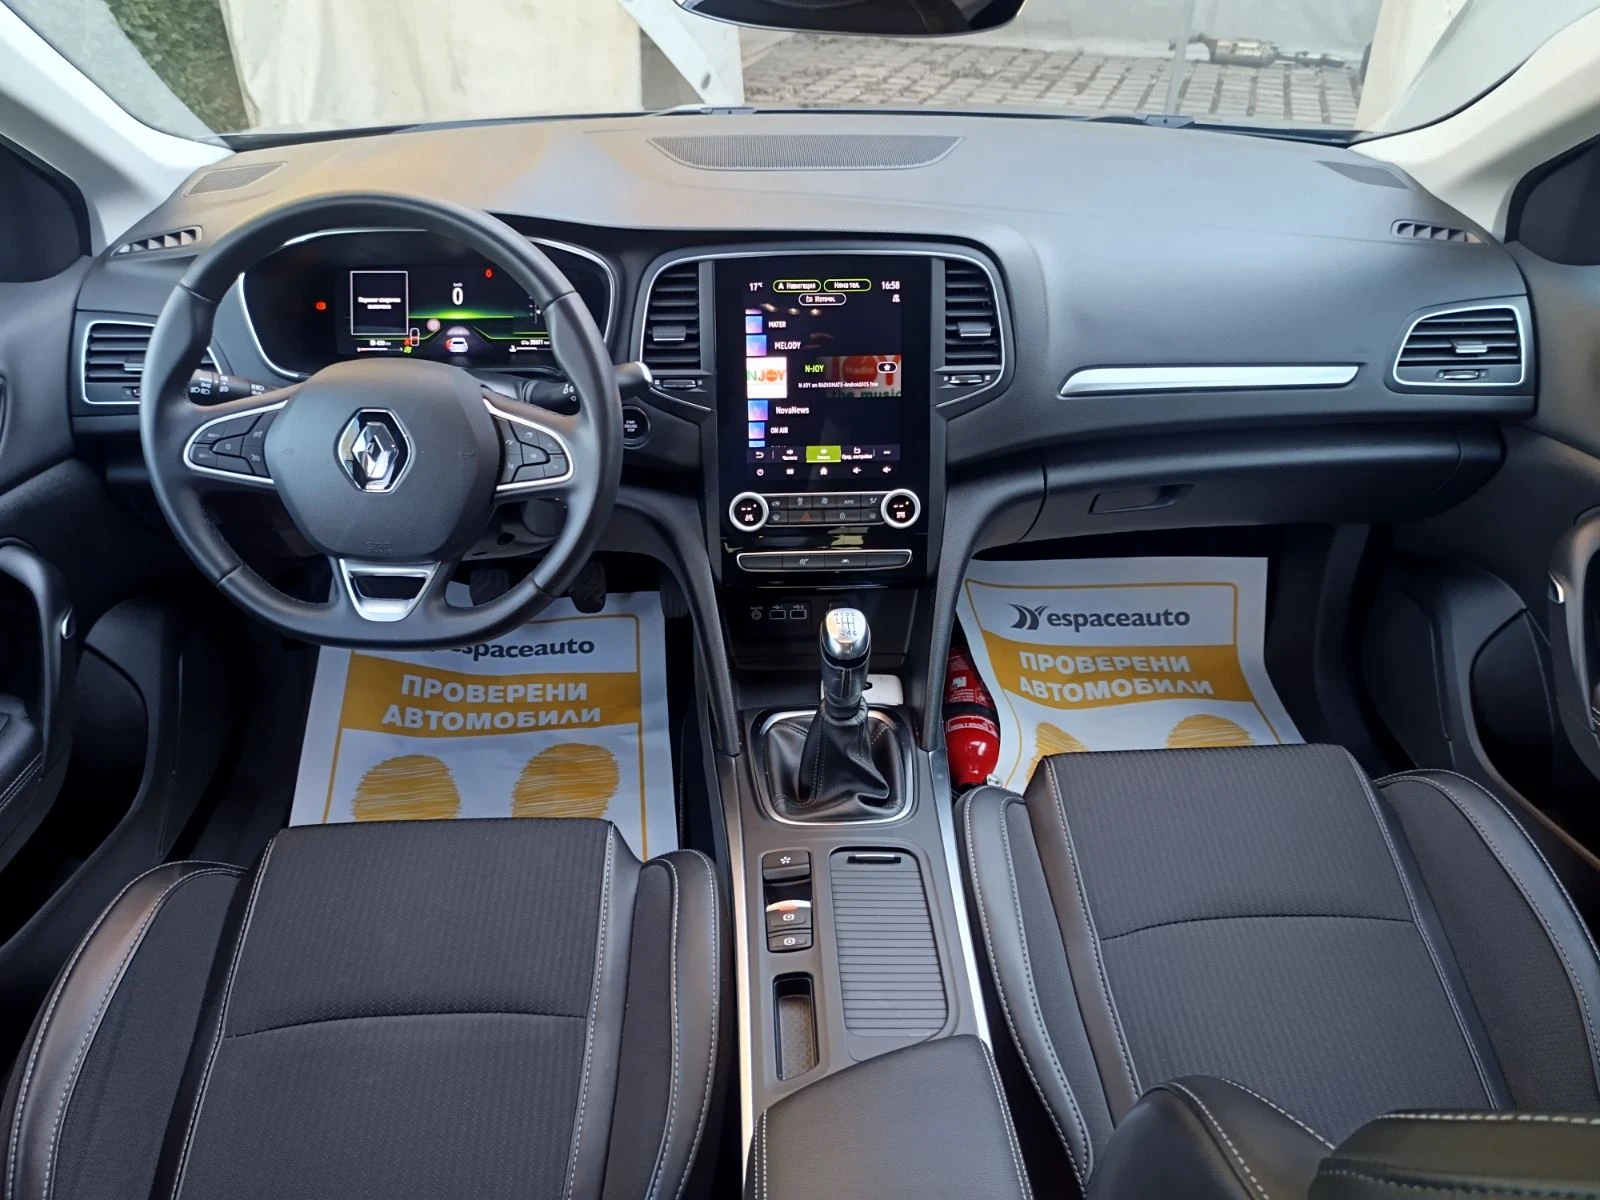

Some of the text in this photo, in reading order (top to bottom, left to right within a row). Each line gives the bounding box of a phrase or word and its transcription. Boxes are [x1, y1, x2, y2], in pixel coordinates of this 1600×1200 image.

[881, 280, 900, 290] 16:58
[774, 341, 801, 350] MELODY
[804, 364, 825, 373] N-JOY
[775, 406, 810, 414] NovaNews
[779, 426, 789, 434] AIR
[1046, 608, 1191, 632] espaceauto
[452, 638, 595, 662] paceauto
[1019, 651, 1191, 675] ПРОВЕРЕНИ
[402, 674, 587, 703] ПРОВЕРЕНИ
[1019, 676, 1214, 702] АВТОМОБИЛИ
[382, 704, 601, 731] АВТОМОБИЛИ
